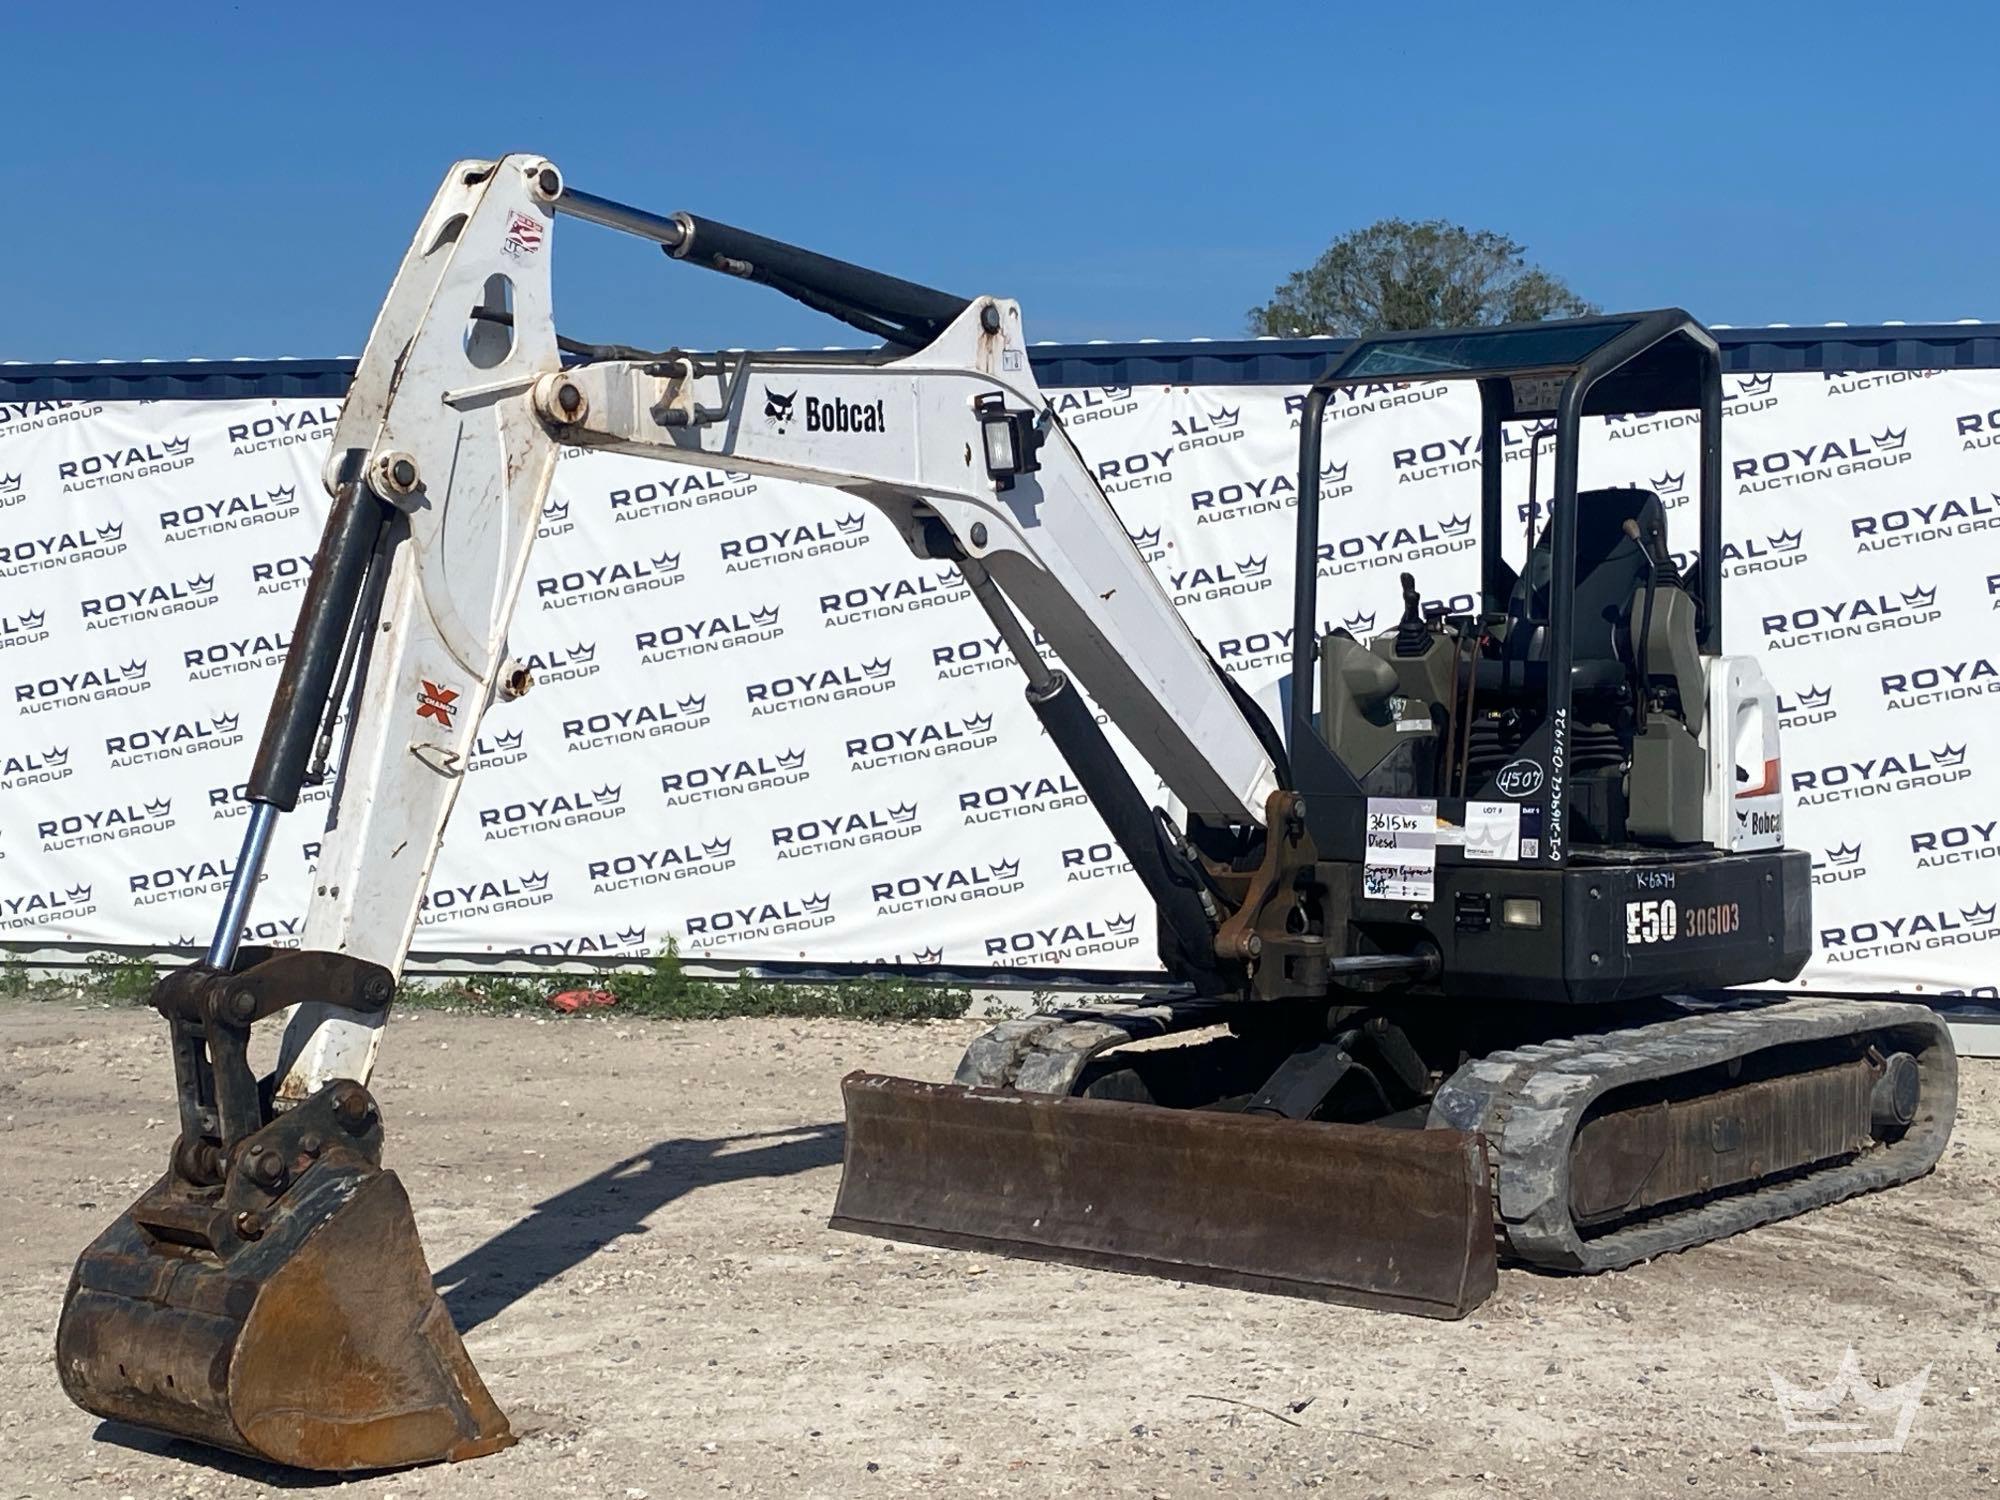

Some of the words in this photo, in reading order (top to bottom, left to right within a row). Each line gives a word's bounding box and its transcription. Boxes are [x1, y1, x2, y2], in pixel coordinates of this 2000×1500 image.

[1379, 386, 1448, 410] GROUP
[1827, 371, 1923, 396] AUCTION
[47, 406, 102, 426] GROUP
[806, 397, 885, 433] Bobcat
[1073, 402, 1139, 426] GROUP
[1721, 397, 1778, 417] ROUP
[228, 406, 337, 443] ROYAL
[1178, 430, 1245, 452] GROUP
[1609, 413, 1700, 441] AUCTION
[59, 444, 164, 480] ROYAL
[234, 434, 306, 456] AUCTION
[1733, 438, 1871, 480] ROYAL
[63, 471, 134, 493] AUCTION
[138, 457, 194, 477] GROUP
[1098, 447, 1174, 480] ROY
[1739, 468, 1832, 495] AUCTION
[1837, 452, 1911, 475] GROUP
[610, 471, 724, 509] ROYAL
[1105, 471, 1173, 494] AUCTIO
[1191, 472, 1299, 511] ROYA
[160, 494, 268, 529] ROYAL
[615, 498, 692, 522] AUCTION
[696, 485, 757, 505] GROUP
[1197, 500, 1281, 525] AUCTION
[1851, 497, 1992, 538] ROYAL
[165, 520, 237, 543] AUCTION
[241, 507, 299, 526] GROUP
[535, 523, 574, 539] OUP
[720, 522, 835, 560] ROYAL
[1857, 527, 1952, 553] AUCTION
[1957, 517, 2000, 534] GRO
[71, 544, 127, 563] GROUP
[726, 550, 803, 573] AUCTION
[808, 536, 869, 556] GROUP
[1409, 539, 1476, 560] GROUP
[1734, 554, 1808, 578] GROUP
[253, 556, 315, 581] ROY
[537, 561, 651, 597] ROYAL
[1170, 565, 1236, 590] YAL
[81, 583, 188, 617] ROYAL
[258, 577, 309, 595] AUCTI
[543, 587, 619, 611] AUCTION
[624, 574, 684, 594] GROUP
[820, 576, 937, 614] ROYAL
[1205, 578, 1273, 601] GROUP
[86, 609, 158, 631] AUCTION
[162, 596, 218, 615] GROUP
[825, 604, 904, 628] AUCTION
[908, 589, 971, 611] GROUP
[1762, 595, 1901, 635] ROYAL
[636, 615, 750, 651] ROYAL
[642, 642, 718, 665] AUCTION
[722, 628, 784, 648] GROUP
[1768, 625, 1862, 651] AUCTION
[1867, 611, 1941, 632] GROUP
[189, 659, 262, 681] AUCTION
[539, 664, 600, 685] GROUP
[1225, 653, 1294, 673] AUCTIO
[1881, 659, 1999, 695] ROYA
[15, 668, 120, 702] ROYAL
[20, 694, 90, 715] AUCTION
[94, 682, 151, 700] GROUP
[746, 666, 862, 703] ROYAL
[752, 693, 829, 717] AUCTION
[833, 680, 895, 700] GROUP
[1887, 685, 1982, 711] AUCTION
[563, 703, 677, 739] ROYAL
[568, 729, 645, 752] AUCTION
[649, 717, 710, 736] GROUP
[1779, 710, 1837, 729] ROUP
[106, 721, 212, 755] ROYAL
[111, 747, 182, 768] AUCTION
[186, 735, 243, 753] GROUP
[846, 721, 963, 757] ROYAL
[851, 749, 930, 772] AUCTION
[935, 736, 997, 755] GROUP
[17, 768, 73, 787] GROUP
[468, 752, 528, 772] GROUP
[662, 758, 776, 793] ROYAL
[1791, 753, 1931, 791] ROYAL
[667, 784, 744, 807] AUCTION
[748, 772, 809, 791] GROUP
[959, 775, 1078, 811] ROYAL
[1501, 771, 1542, 791] 4507
[1798, 782, 1891, 807] AUCTION
[1896, 769, 1971, 790] GROUP
[38, 806, 145, 839] ROYAL
[480, 793, 593, 827] ROYAL
[485, 819, 561, 841] AUCTION
[565, 807, 625, 826] GROUP
[964, 802, 1045, 825] AUCTION
[1050, 793, 1089, 810] GRO
[1370, 814, 1401, 831] 3615
[1752, 811, 1782, 835] Bobca
[44, 831, 115, 852] AUCTION
[119, 820, 175, 838] GROUP
[772, 811, 888, 846] ROYAL
[777, 837, 855, 860] AUCTION
[859, 825, 921, 845] GROUP
[1368, 832, 1397, 849] Diesel
[1911, 821, 1998, 853] ROY
[588, 845, 702, 880] ROYAL
[1067, 861, 1136, 882] AUCTIO
[1916, 846, 2000, 869] AUCTIO
[594, 872, 670, 894] AUCTION
[675, 860, 735, 879] GROUP
[871, 867, 990, 902] ROYAL
[0, 892, 66, 916] YAL
[134, 885, 206, 906] AUCTION
[493, 894, 553, 912] GROUP
[877, 894, 956, 916] AUCTION
[960, 882, 1024, 901] GROUP
[0, 917, 35, 930] TION
[38, 905, 97, 924] GROUP
[686, 901, 801, 935] ROYAL
[691, 928, 769, 949] AUCTION
[773, 916, 835, 934] GROUP
[1626, 900, 1677, 944] E50
[1685, 903, 1739, 938] 306103
[1820, 912, 1960, 948] ROYAL
[985, 922, 1105, 956] ROYAL
[1076, 937, 1139, 956] GROUP
[1827, 940, 1921, 963] AUCTION
[1926, 930, 2000, 948] GROUP
